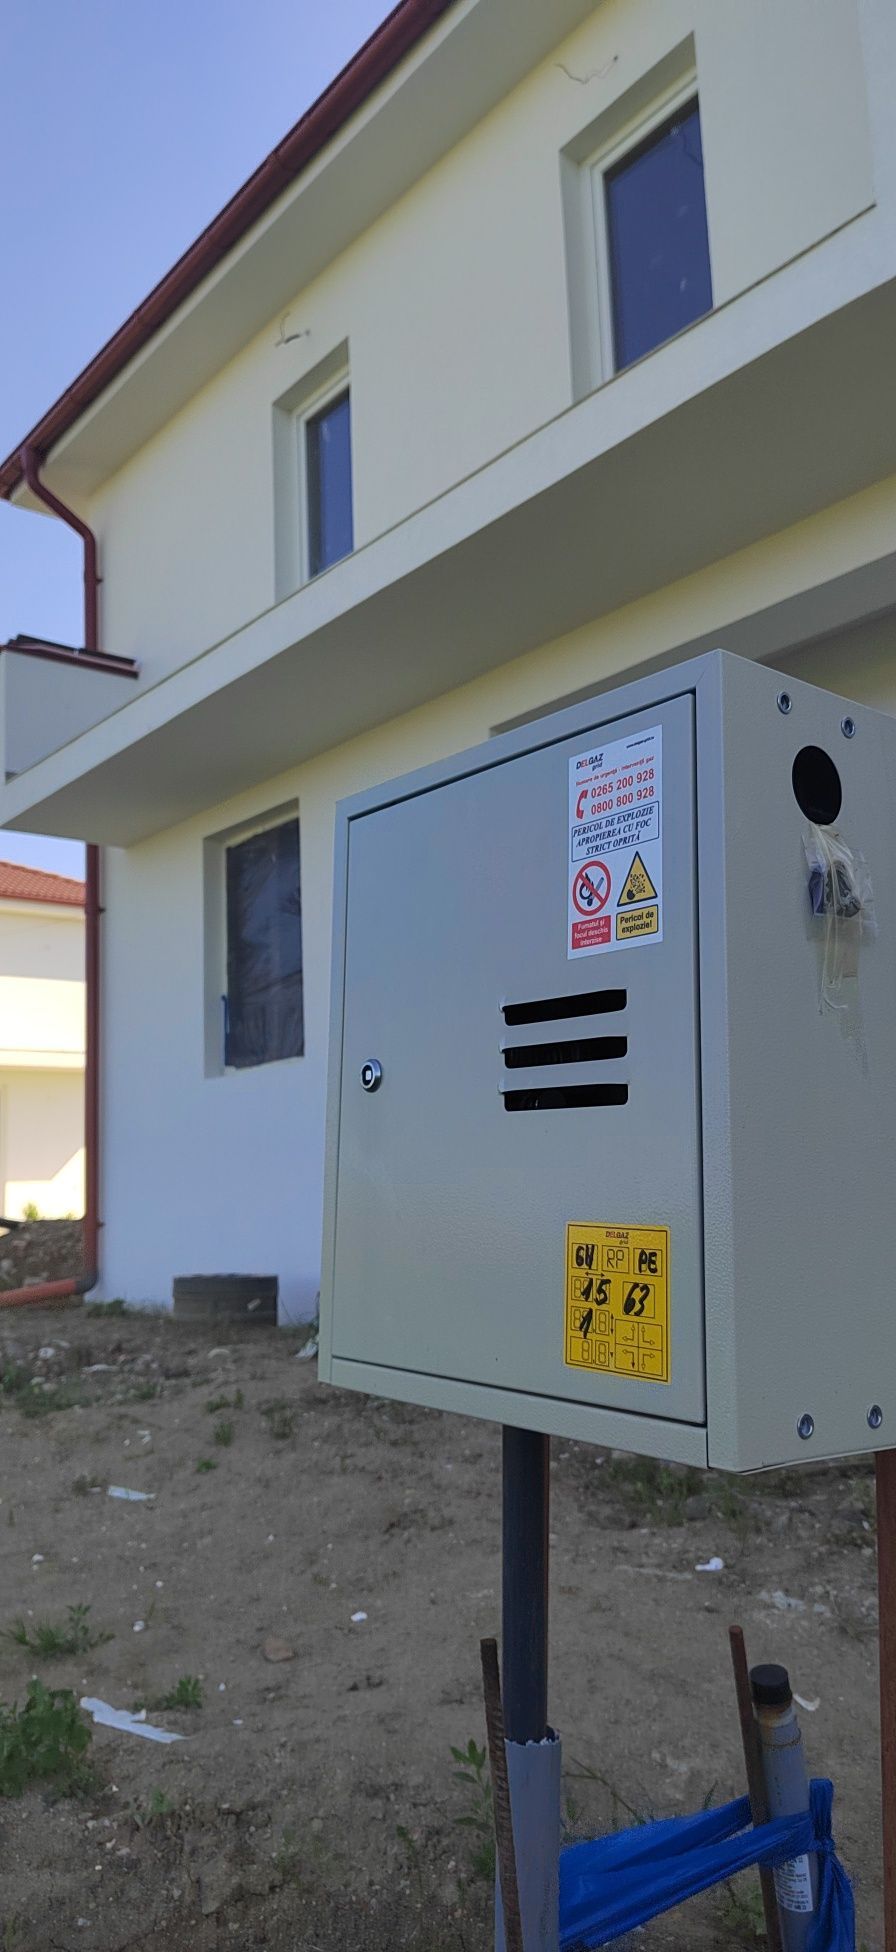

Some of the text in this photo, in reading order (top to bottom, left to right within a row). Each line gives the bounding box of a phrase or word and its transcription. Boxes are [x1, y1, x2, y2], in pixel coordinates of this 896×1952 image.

[576, 753, 604, 770] DELGAZ
[591, 768, 654, 798] 0265 200 928
[591, 786, 654, 815] 0800 800 928
[573, 806, 654, 838] PERICOL DE EXPLOZIE
[576, 818, 652, 848] APROPIEREA CU FOC
[586, 841, 611, 856] STRICT
[620, 910, 654, 924] Pericol de
[605, 1231, 629, 1239] DELGAZ
[607, 1248, 625, 1269] RP
[638, 1249, 658, 1274] PE
[623, 1283, 650, 1316] 63
